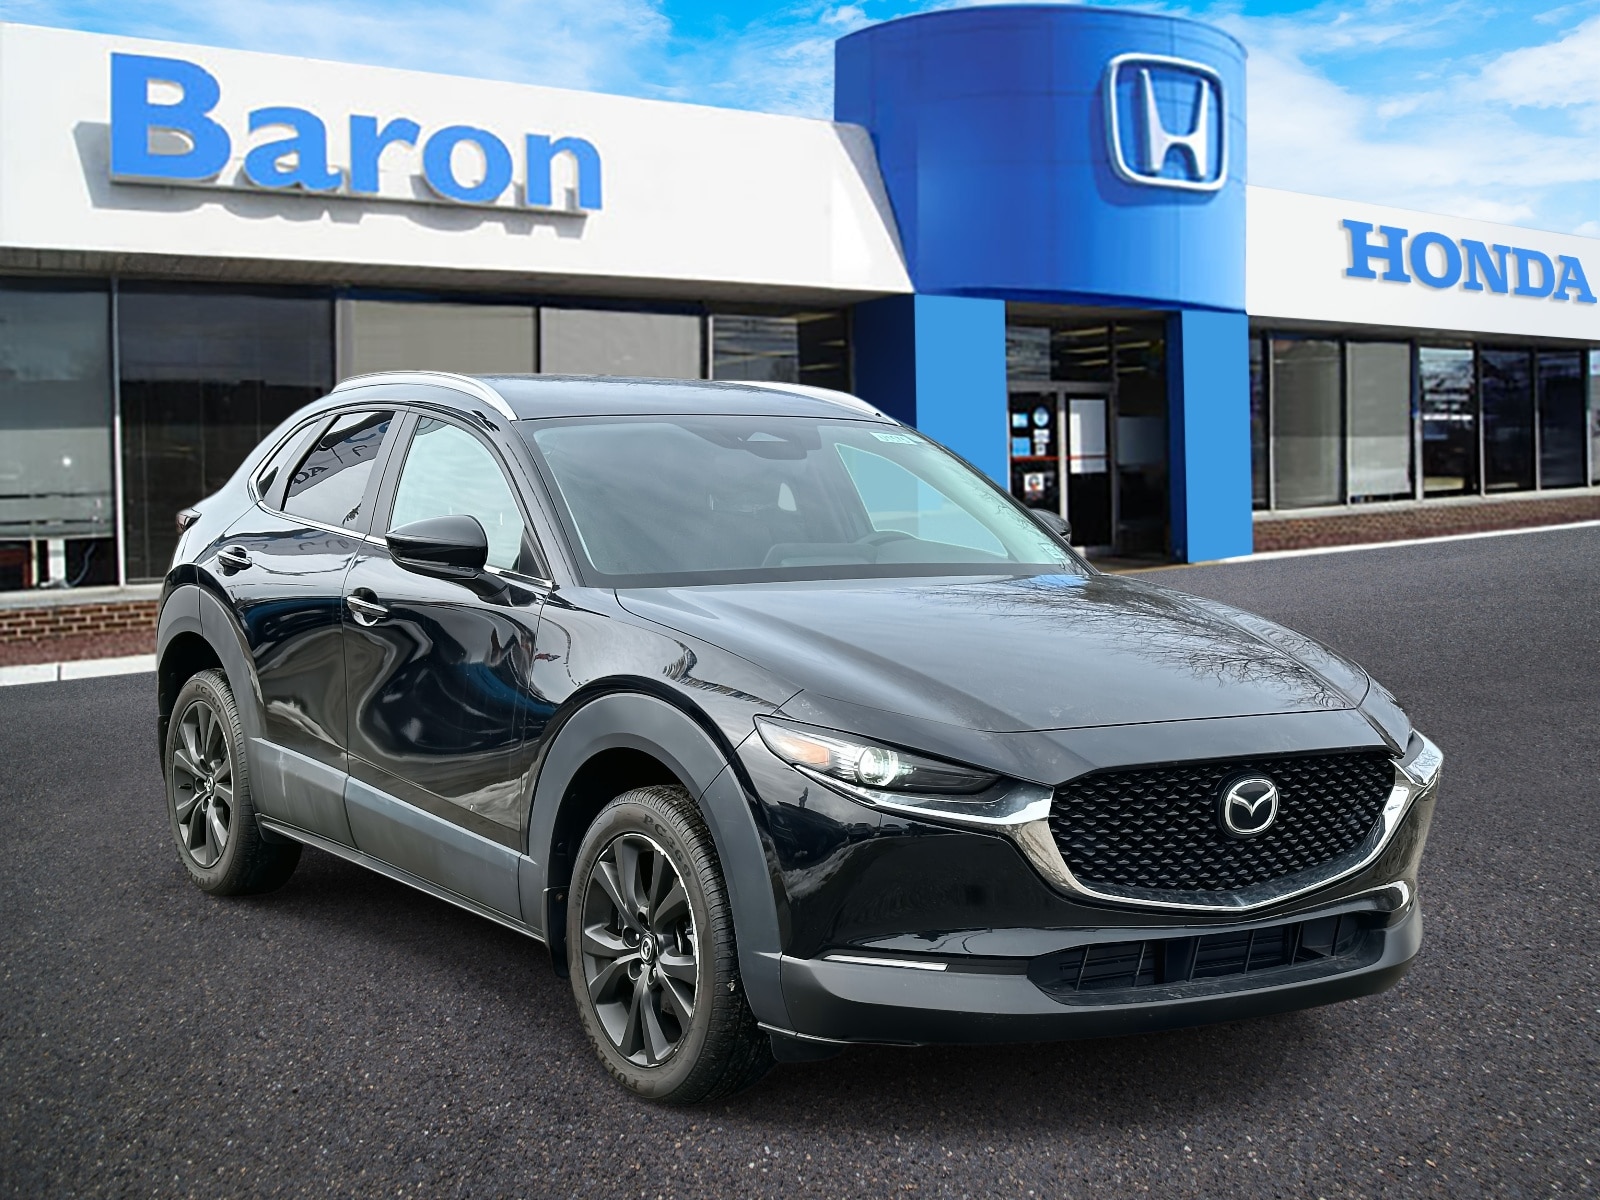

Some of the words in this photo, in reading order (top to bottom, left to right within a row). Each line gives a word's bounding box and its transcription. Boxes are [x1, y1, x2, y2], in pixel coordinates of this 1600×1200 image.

[110, 51, 603, 211] Baron
[1342, 218, 1597, 304] HONDA
[642, 813, 692, 877] PC369
